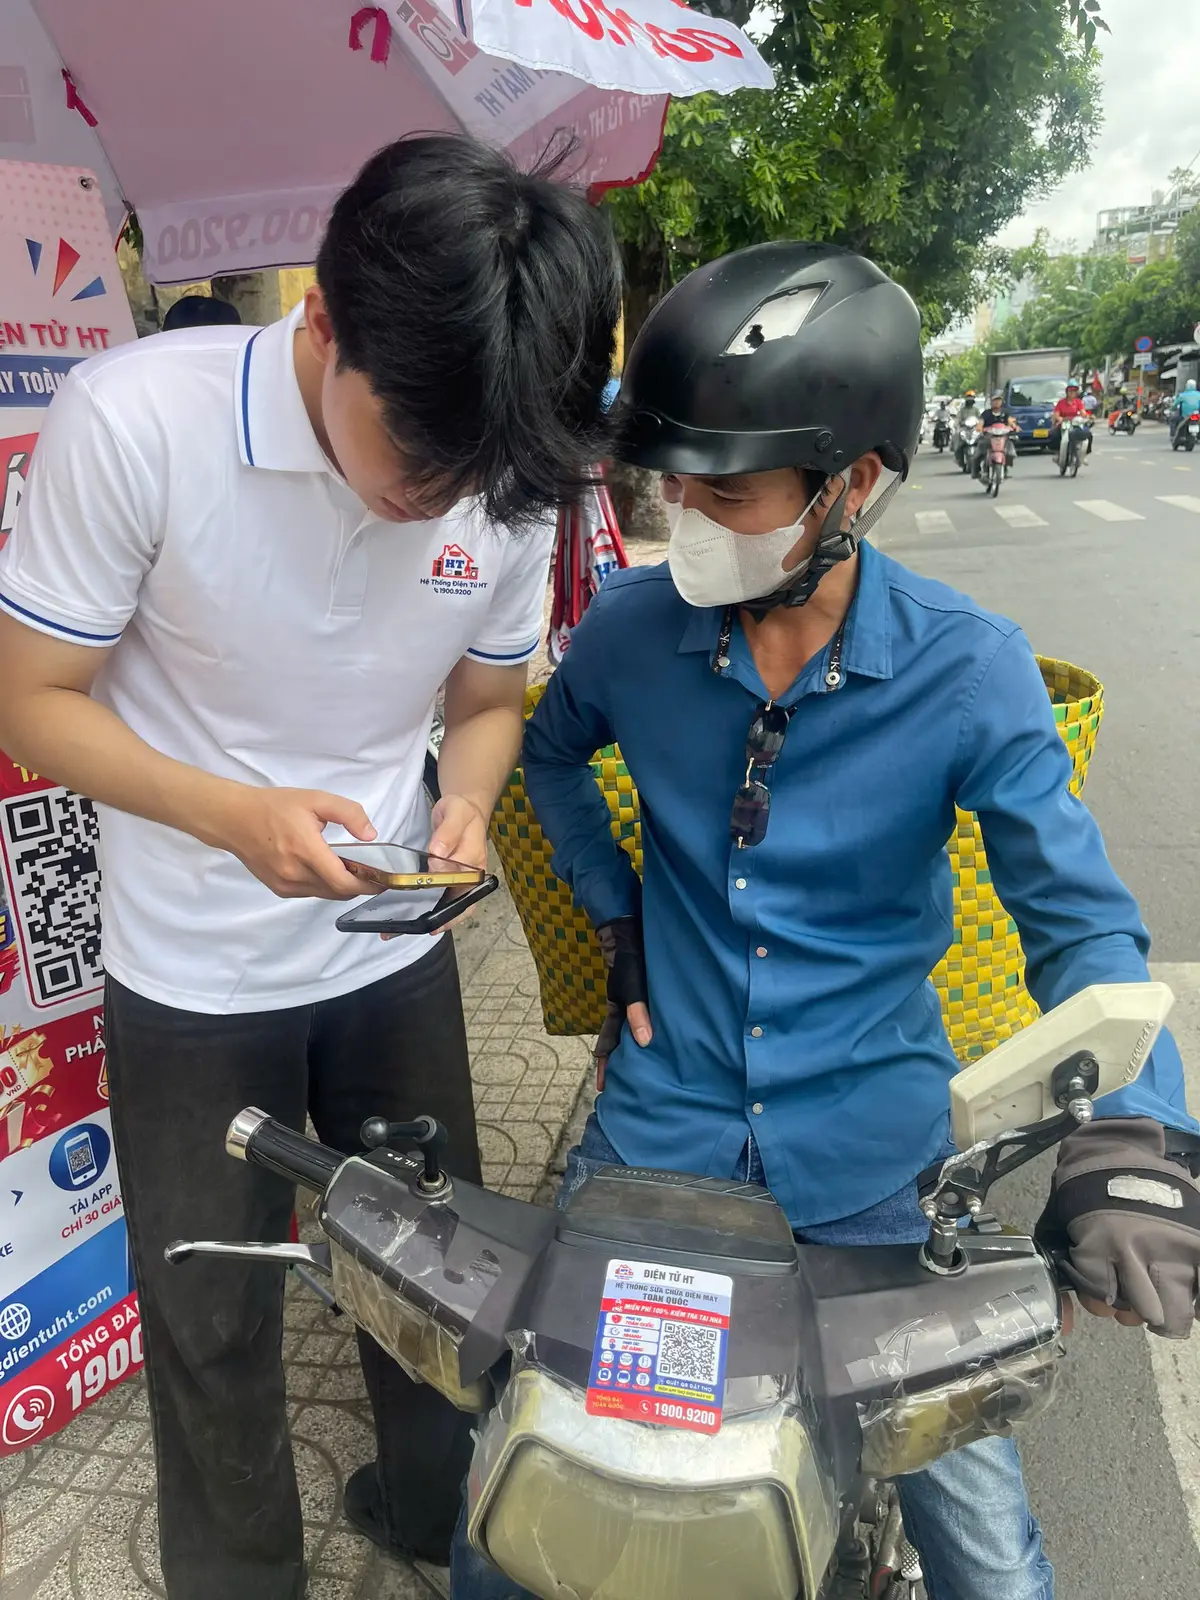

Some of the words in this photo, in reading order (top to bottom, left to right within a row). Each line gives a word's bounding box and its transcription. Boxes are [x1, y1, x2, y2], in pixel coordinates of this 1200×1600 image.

[30, 319, 67, 348] TỬ
[76, 327, 109, 350] HT
[445, 559, 465, 569] HT
[431, 579, 451, 587] Thống
[452, 580, 468, 588] Điện
[440, 587, 472, 596] 1900.9200
[65, 1031, 107, 1063] PHẦ
[69, 1197, 89, 1215] TẢI
[92, 1183, 112, 1204] APP
[61, 1216, 83, 1239] CHỈ
[85, 1210, 99, 1225] 30
[101, 1194, 122, 1215] GIÂ
[643, 1267, 666, 1282] ĐIỆN
[668, 1270, 681, 1282] TỬ
[682, 1275, 694, 1284] HT
[56, 1326, 110, 1370] TỔNG
[653, 1401, 715, 1426] 1900.9200
